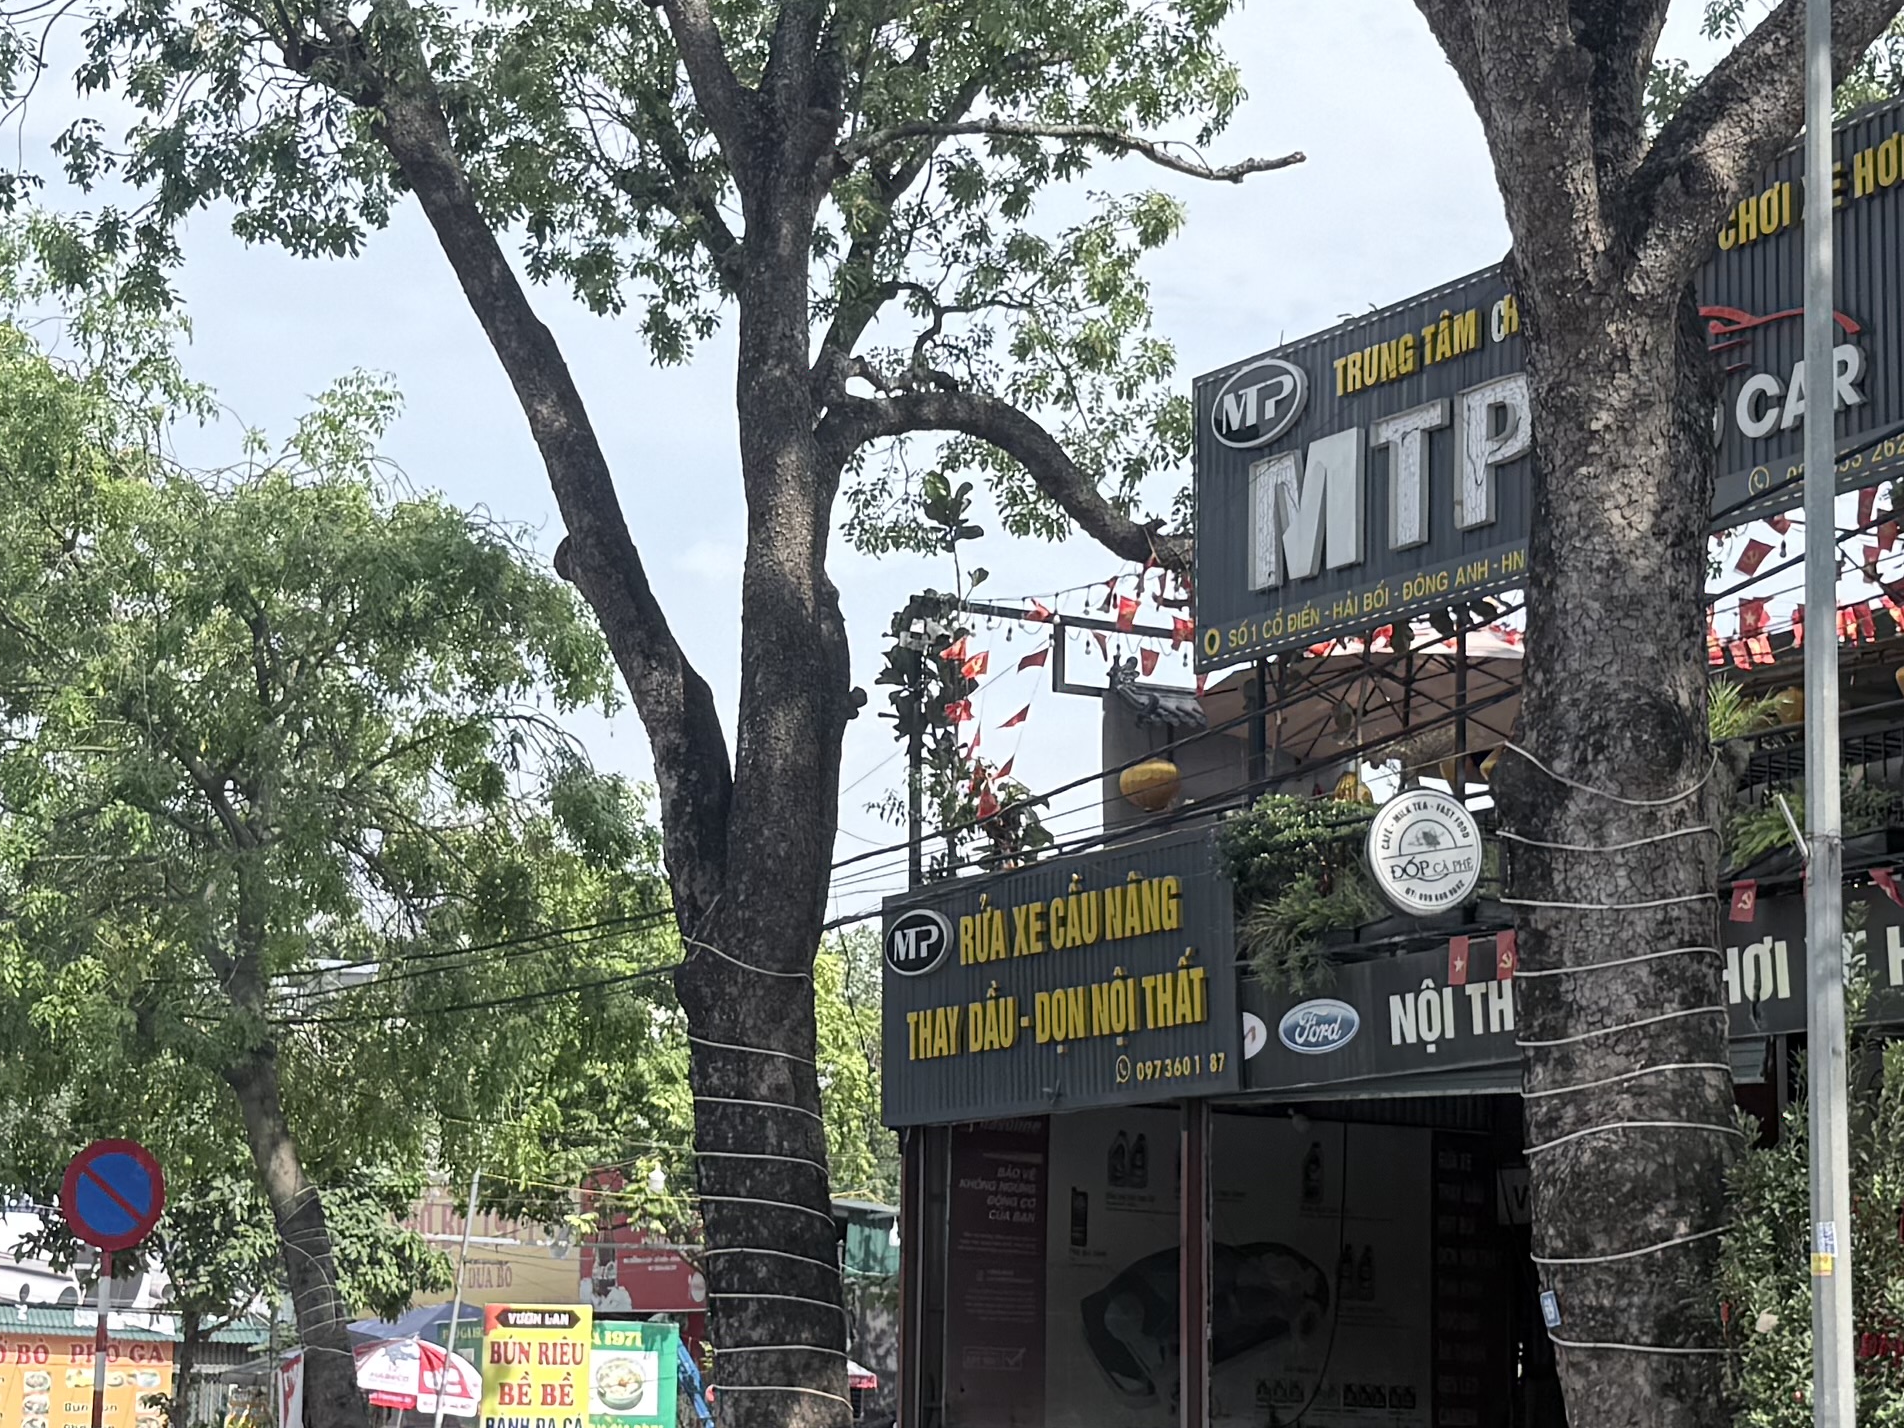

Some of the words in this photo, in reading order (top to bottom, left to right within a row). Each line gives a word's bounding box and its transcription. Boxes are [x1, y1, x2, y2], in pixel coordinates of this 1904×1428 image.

[1717, 180, 1792, 251] CHƠI
[1333, 333, 1416, 397] TRUNG
[1422, 308, 1478, 366] TÂM
[1248, 372, 1533, 592] MTP
[1228, 619, 1248, 648] SỐ
[1332, 590, 1359, 621] HẢI
[1363, 579, 1389, 613] BỐI
[1403, 567, 1448, 603] ĐÔNG
[1454, 560, 1489, 588] ANH
[1501, 549, 1526, 576] HN
[1412, 801, 1429, 812] TEA
[1454, 816, 1470, 839] FOOD
[894, 924, 940, 962] MTP
[959, 892, 1007, 966] RỬA
[1012, 901, 1045, 958] XE
[1050, 873, 1099, 951] CẦU
[1104, 870, 1182, 942] NÂNG
[906, 1005, 960, 1061] THAY
[968, 980, 1016, 1053] DẦU
[1035, 985, 1086, 1054] DỌN
[1091, 966, 1137, 1046] NỘI
[1142, 947, 1208, 1030] THẤT
[1295, 1010, 1342, 1045] Ford
[1389, 978, 1455, 1054] NỘI
[1465, 978, 1516, 1036] TH
[16, 1337, 50, 1365] BÒ
[490, 1334, 532, 1366] BÚN
[538, 1335, 585, 1366] RIÊU
[498, 1371, 532, 1407] BỀ
[540, 1371, 575, 1407] BỀ
